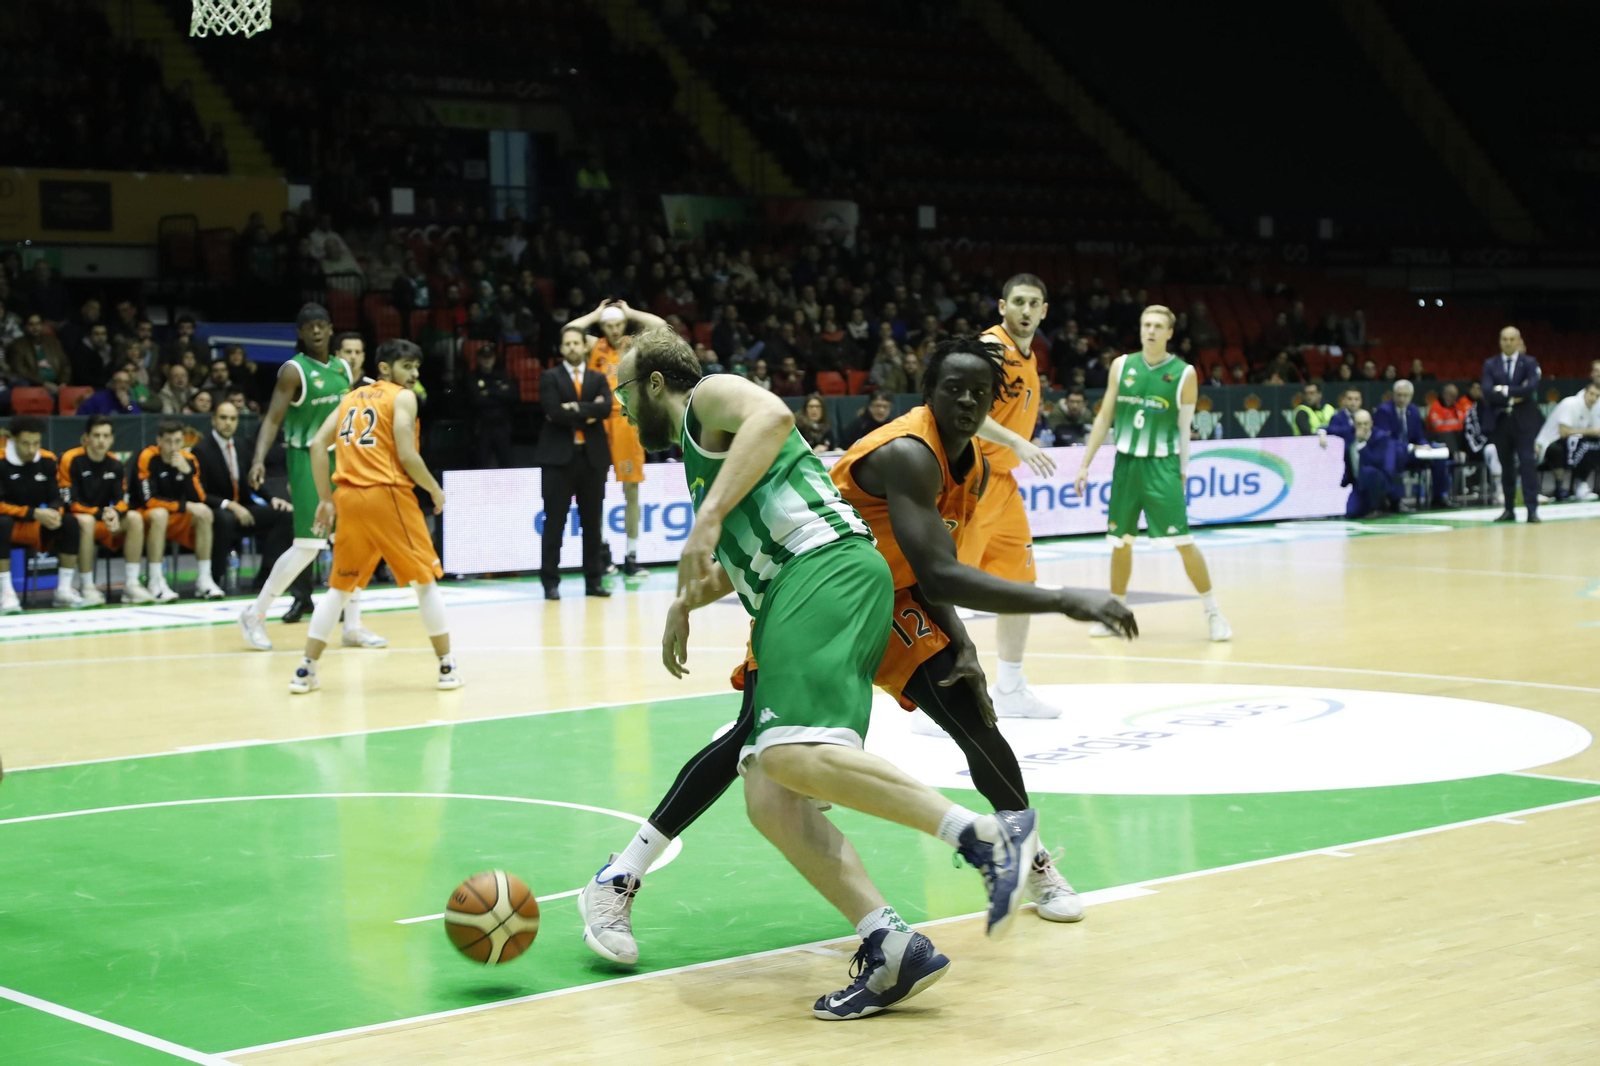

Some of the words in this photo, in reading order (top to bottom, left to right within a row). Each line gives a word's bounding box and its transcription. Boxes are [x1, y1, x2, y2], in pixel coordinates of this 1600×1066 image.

[339, 406, 377, 447] 42
[1133, 409, 1145, 430] 6
[1018, 481, 1113, 515] nerg
[1185, 466, 1261, 507] plus
[892, 607, 932, 649] 12
